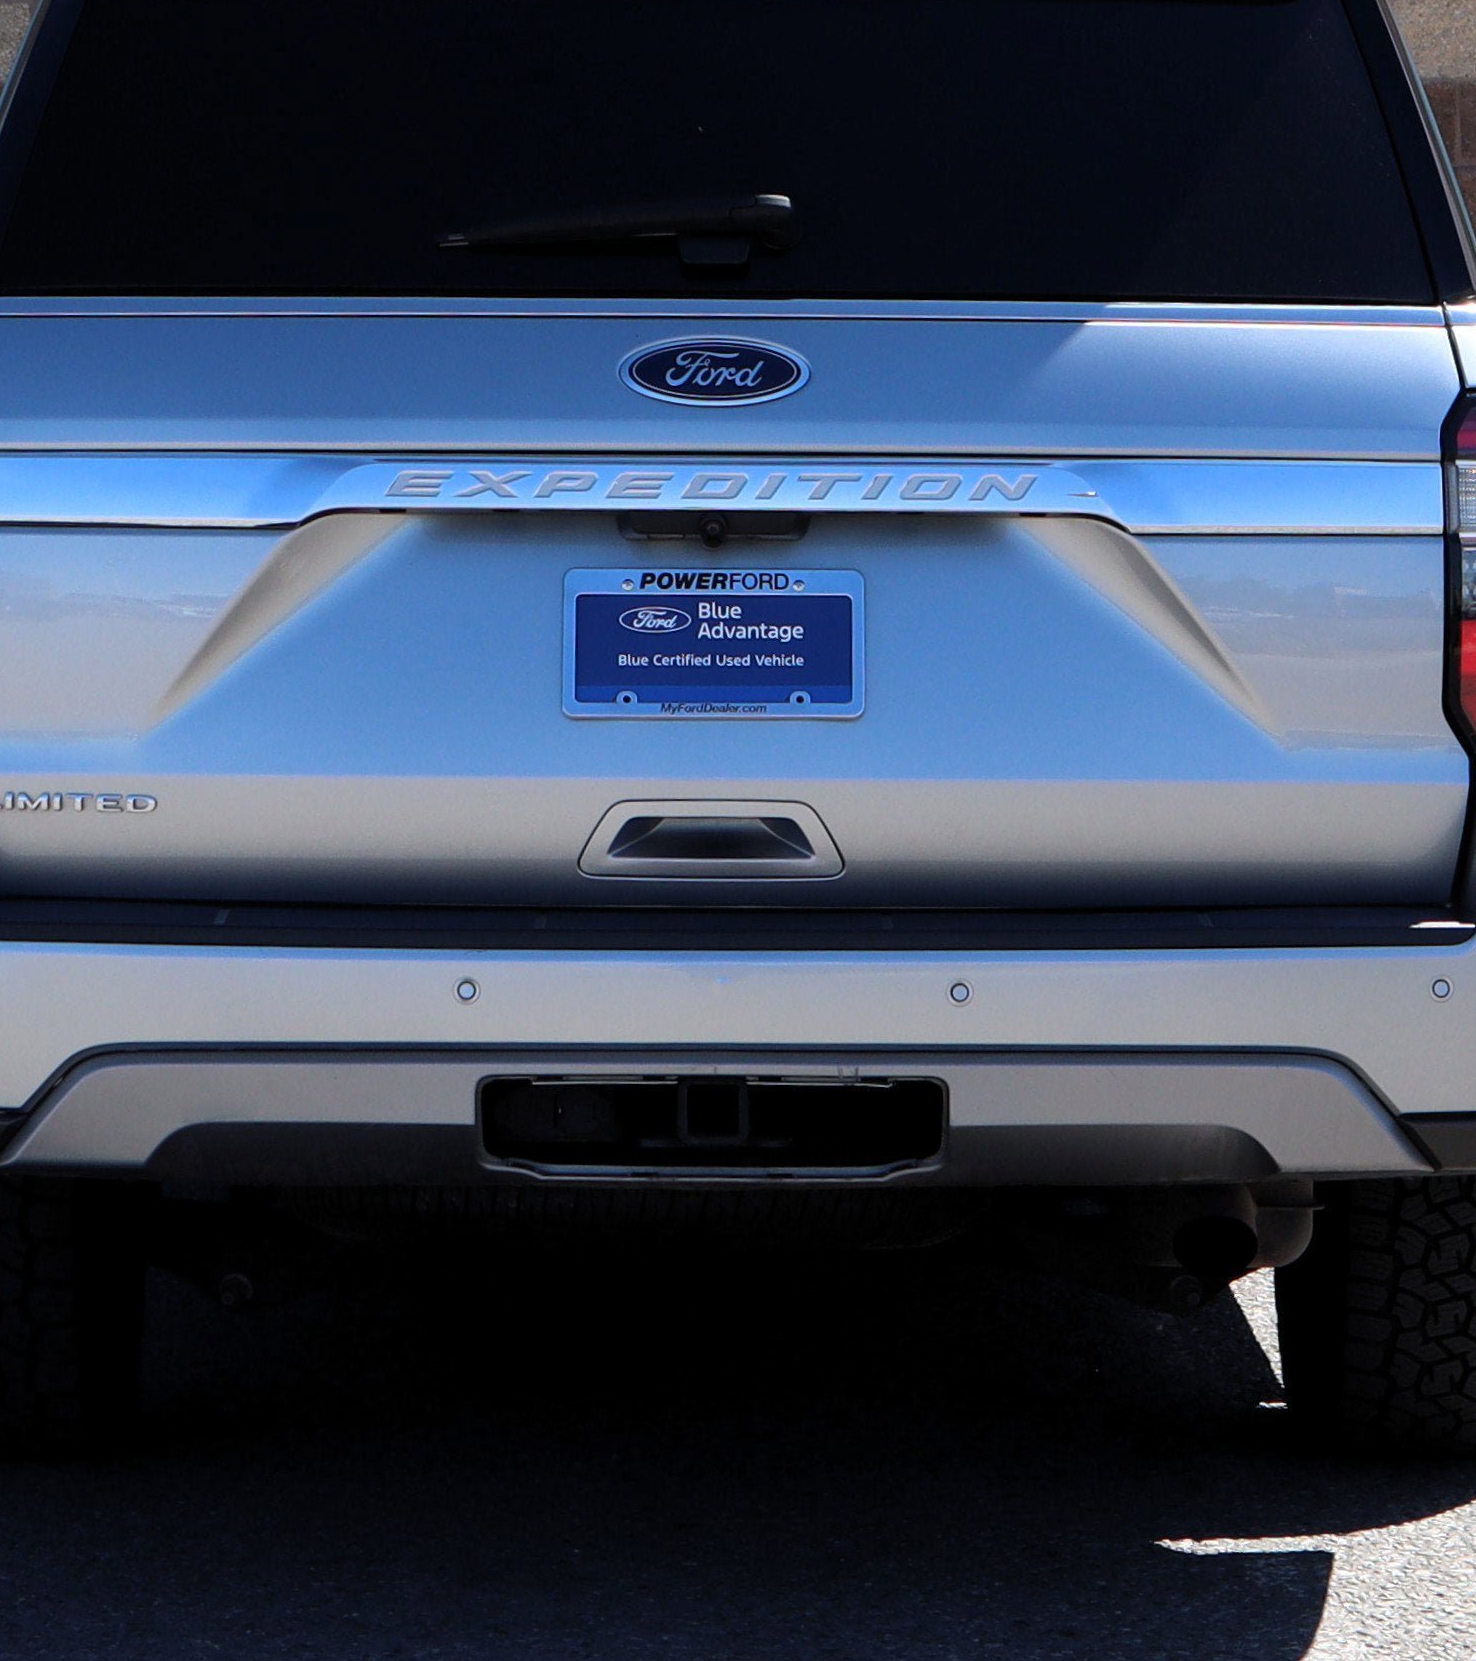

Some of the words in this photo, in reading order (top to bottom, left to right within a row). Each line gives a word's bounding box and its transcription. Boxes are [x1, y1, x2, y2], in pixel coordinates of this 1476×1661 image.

[665, 348, 764, 390] Ford
[384, 469, 1039, 503] EXPEDITION
[632, 610, 678, 630] Ford
[698, 601, 741, 620] Blue
[697, 621, 804, 643] Advantage
[617, 653, 649, 667] Blue
[653, 653, 711, 667] Certified
[717, 653, 751, 667] Used
[754, 653, 805, 667] Vehicle
[659, 702, 767, 715] MyFordDealer.com
